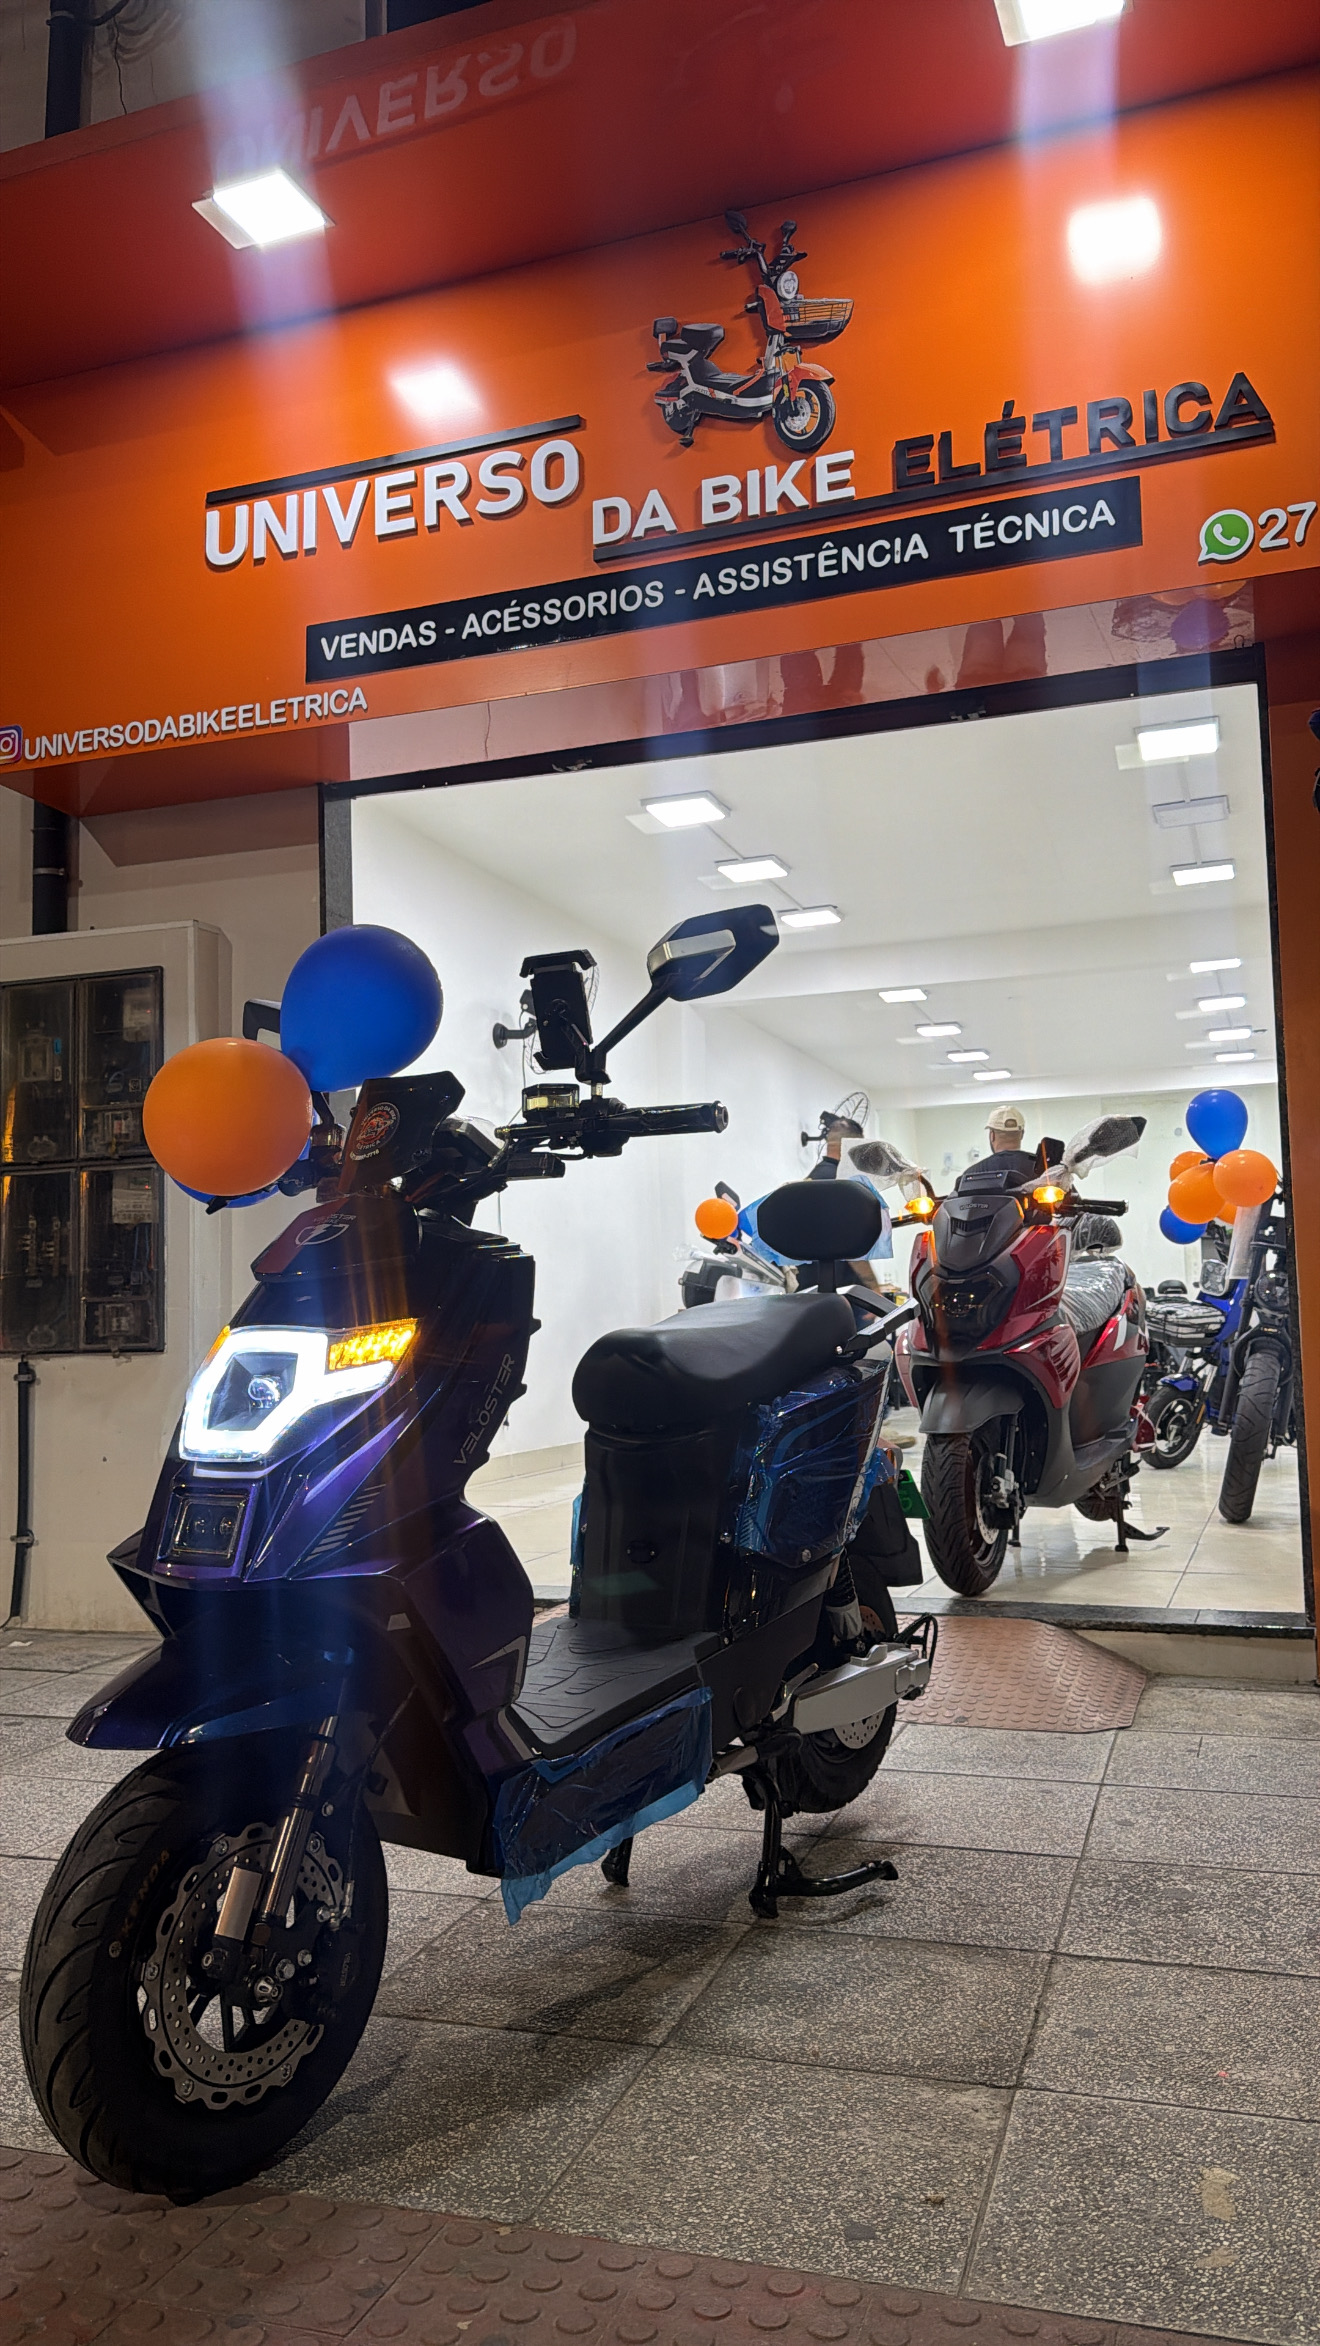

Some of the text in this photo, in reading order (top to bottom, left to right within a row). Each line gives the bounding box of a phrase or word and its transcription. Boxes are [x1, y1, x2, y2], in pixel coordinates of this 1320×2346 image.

[205, 439, 581, 567] UNIVERSO
[593, 372, 1271, 546] DA BIKE ELÉTRICA
[320, 620, 437, 661] VENDAS
[461, 580, 664, 640] ACÉSSORIOS
[693, 533, 929, 600] ASSISTÊNCIA
[948, 499, 1116, 553] TÉCNICA
[1258, 501, 1317, 550] 27
[24, 687, 368, 761] UNIVERSODABIKEELETRICA
[454, 1353, 515, 1464] VELOSTER
